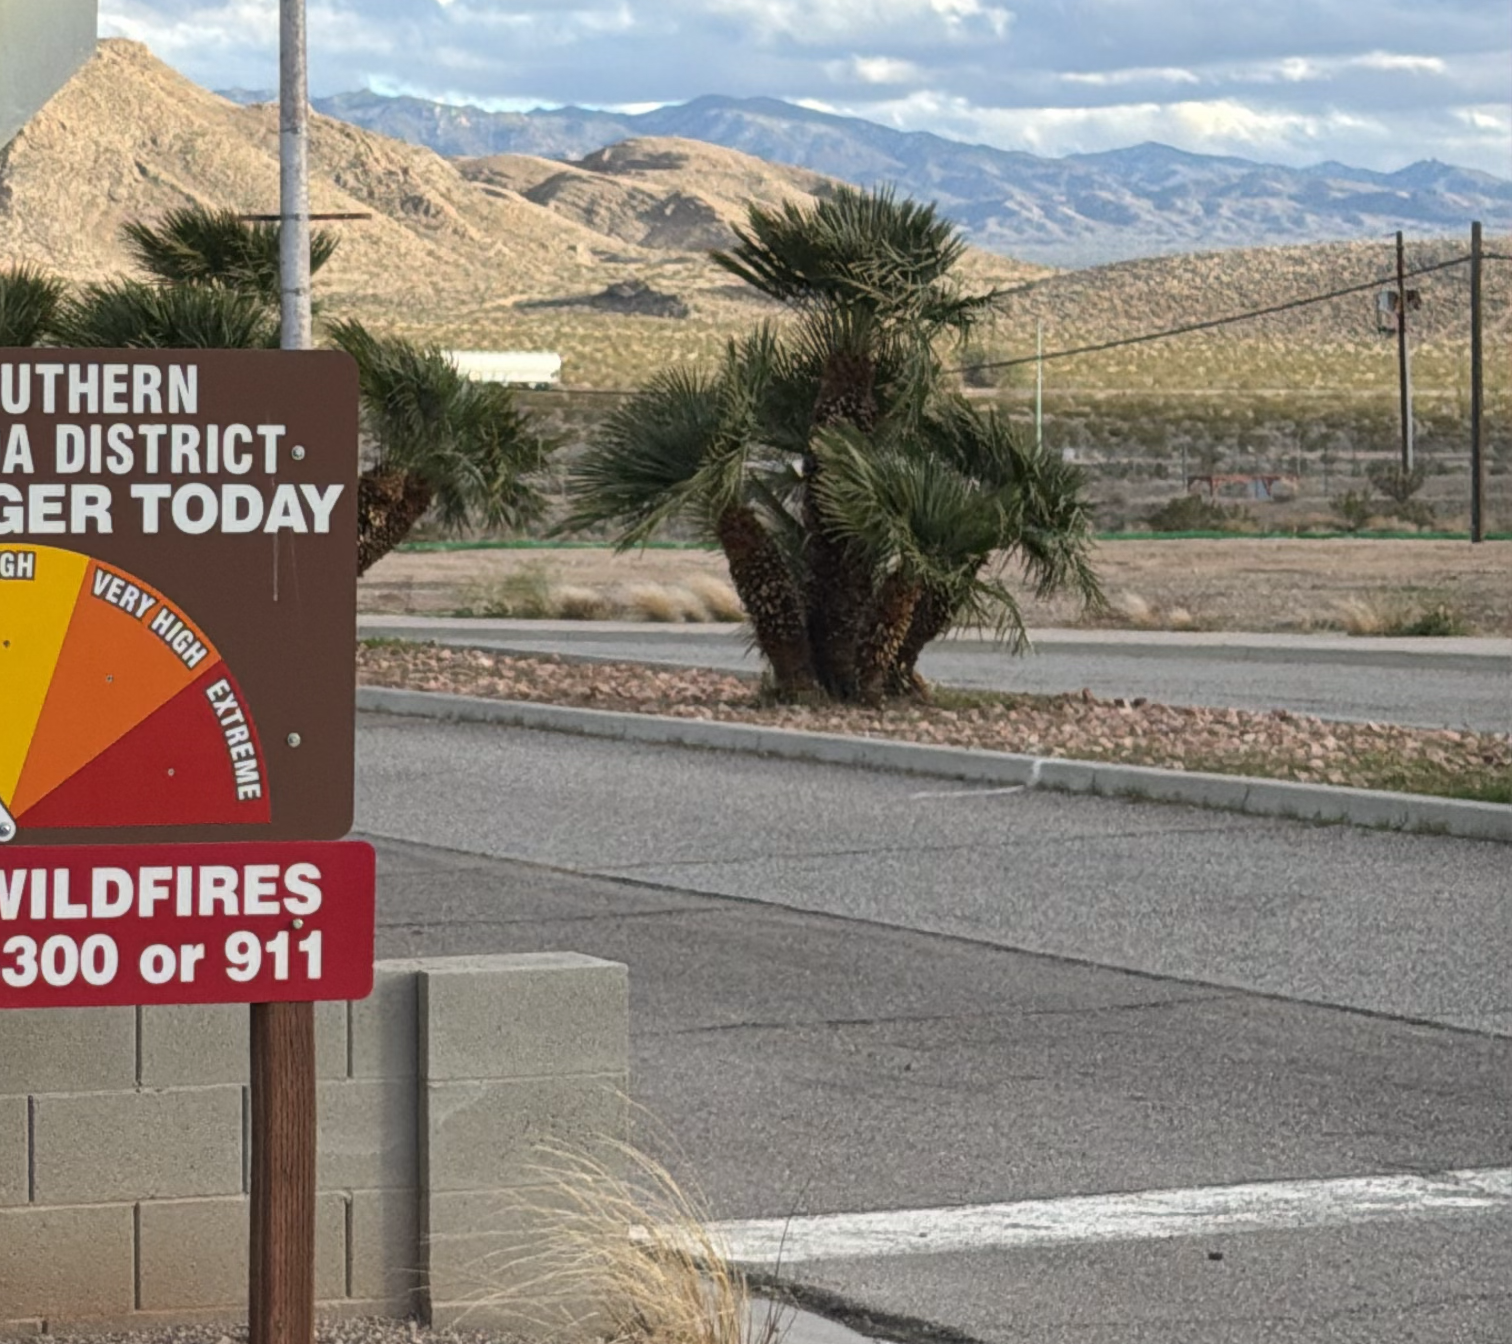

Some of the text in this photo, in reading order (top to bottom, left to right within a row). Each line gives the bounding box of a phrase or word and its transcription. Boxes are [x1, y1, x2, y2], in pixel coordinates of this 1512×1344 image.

[56, 424, 285, 474] DISTRICT
[131, 483, 344, 534] TODAY
[94, 570, 206, 667] VERY HIGH
[207, 680, 260, 799] EXTREME
[140, 944, 204, 984] or
[225, 931, 321, 981] 911
